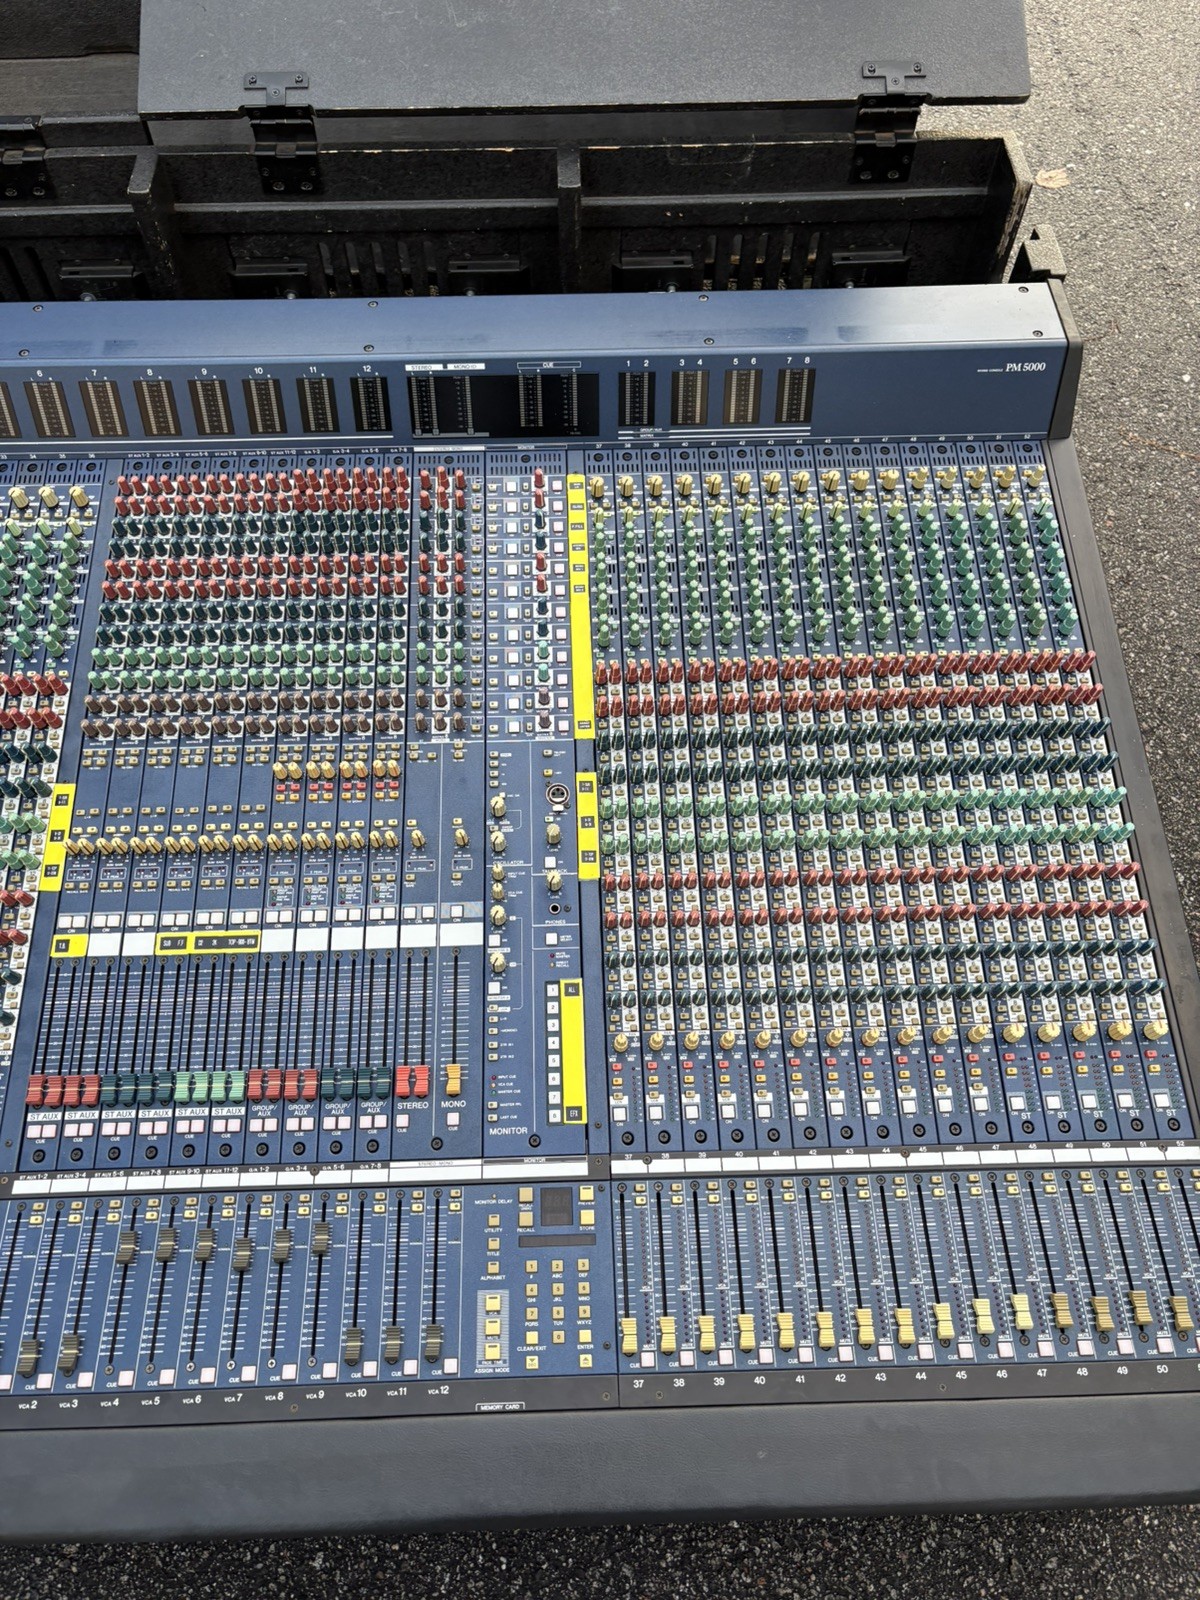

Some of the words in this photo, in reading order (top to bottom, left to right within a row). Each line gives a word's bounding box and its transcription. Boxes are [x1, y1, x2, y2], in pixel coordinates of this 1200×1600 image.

[1005, 363, 1021, 372] PM
[1023, 362, 1046, 371] 5000
[1037, 1369, 1047, 1377] 47
[1077, 1368, 1088, 1377] 48
[1117, 1366, 1128, 1375] 49
[1156, 1365, 1168, 1374] 50
[835, 1374, 846, 1382] 42
[875, 1373, 887, 1382] 43
[916, 1372, 927, 1380] 44
[956, 1371, 967, 1379] 45
[996, 1370, 1008, 1378] 46
[674, 1378, 685, 1387] 38
[714, 1377, 725, 1386] 39
[754, 1376, 766, 1385] 40
[795, 1375, 805, 1383] 41
[634, 1380, 644, 1388] 37
[357, 1389, 367, 1397] 10
[399, 1388, 407, 1396] 11
[440, 1386, 449, 1394] 12
[236, 1394, 242, 1402] 7
[277, 1392, 284, 1400] 8
[318, 1390, 324, 1399] 9
[112, 1398, 119, 1406] 4
[153, 1397, 160, 1405] 5
[195, 1395, 201, 1404] 6
[71, 1400, 78, 1408] 3
